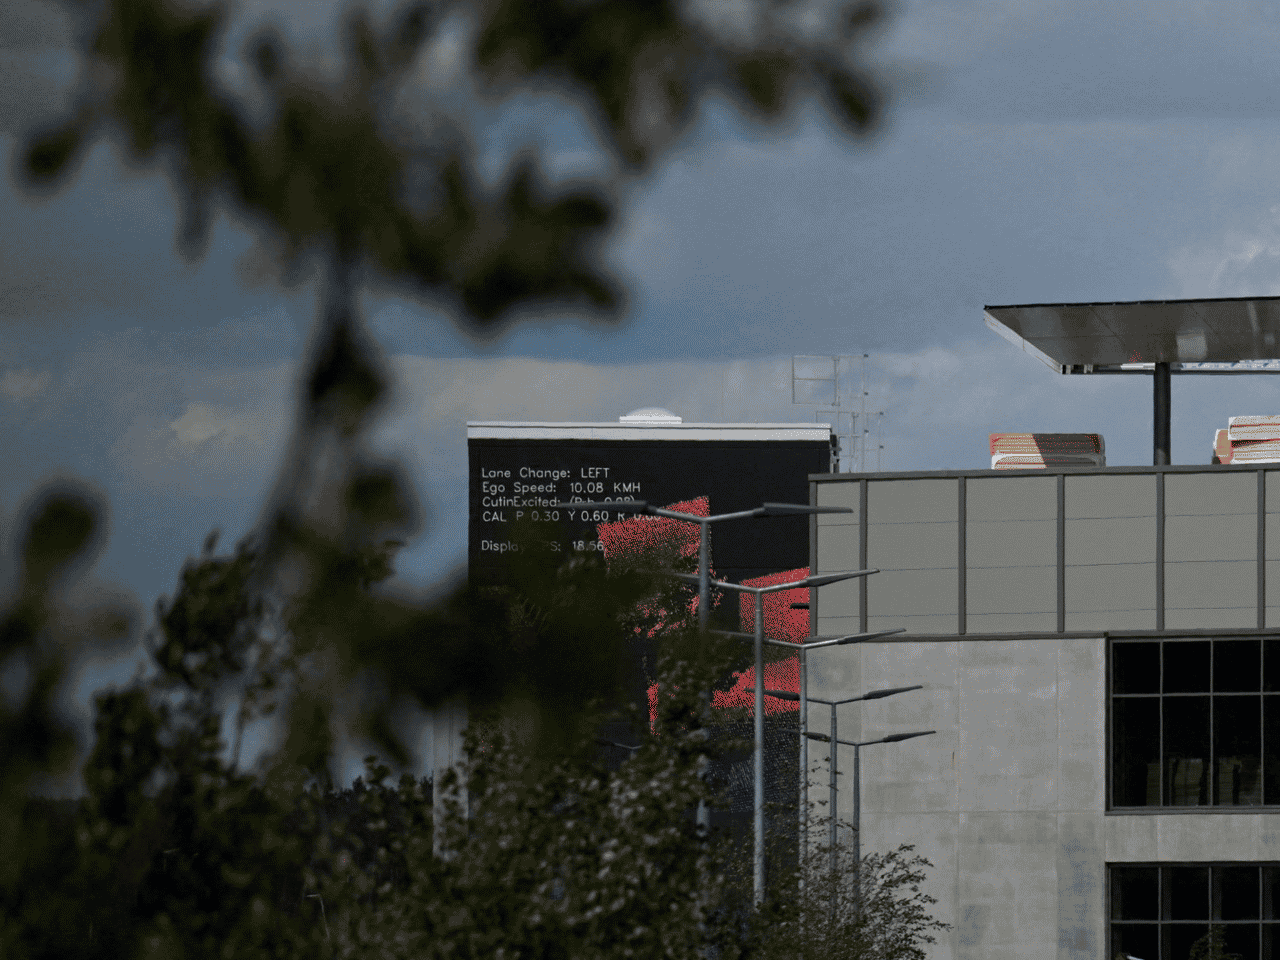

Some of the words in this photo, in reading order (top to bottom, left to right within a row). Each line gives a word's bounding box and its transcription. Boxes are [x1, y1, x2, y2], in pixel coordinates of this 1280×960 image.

[481, 467, 511, 478] Lane
[519, 467, 571, 481] Change:
[581, 467, 610, 478] LEFT
[482, 481, 506, 496] Ego
[513, 482, 557, 495] Speed:
[570, 482, 604, 493] 10.08
[613, 482, 641, 493] KMH
[482, 511, 507, 522] CAL
[516, 511, 524, 520] P
[531, 511, 560, 521] 0.30
[568, 510, 576, 521] Y
[581, 510, 609, 521] 0.60
[572, 541, 604, 552] 18.56
